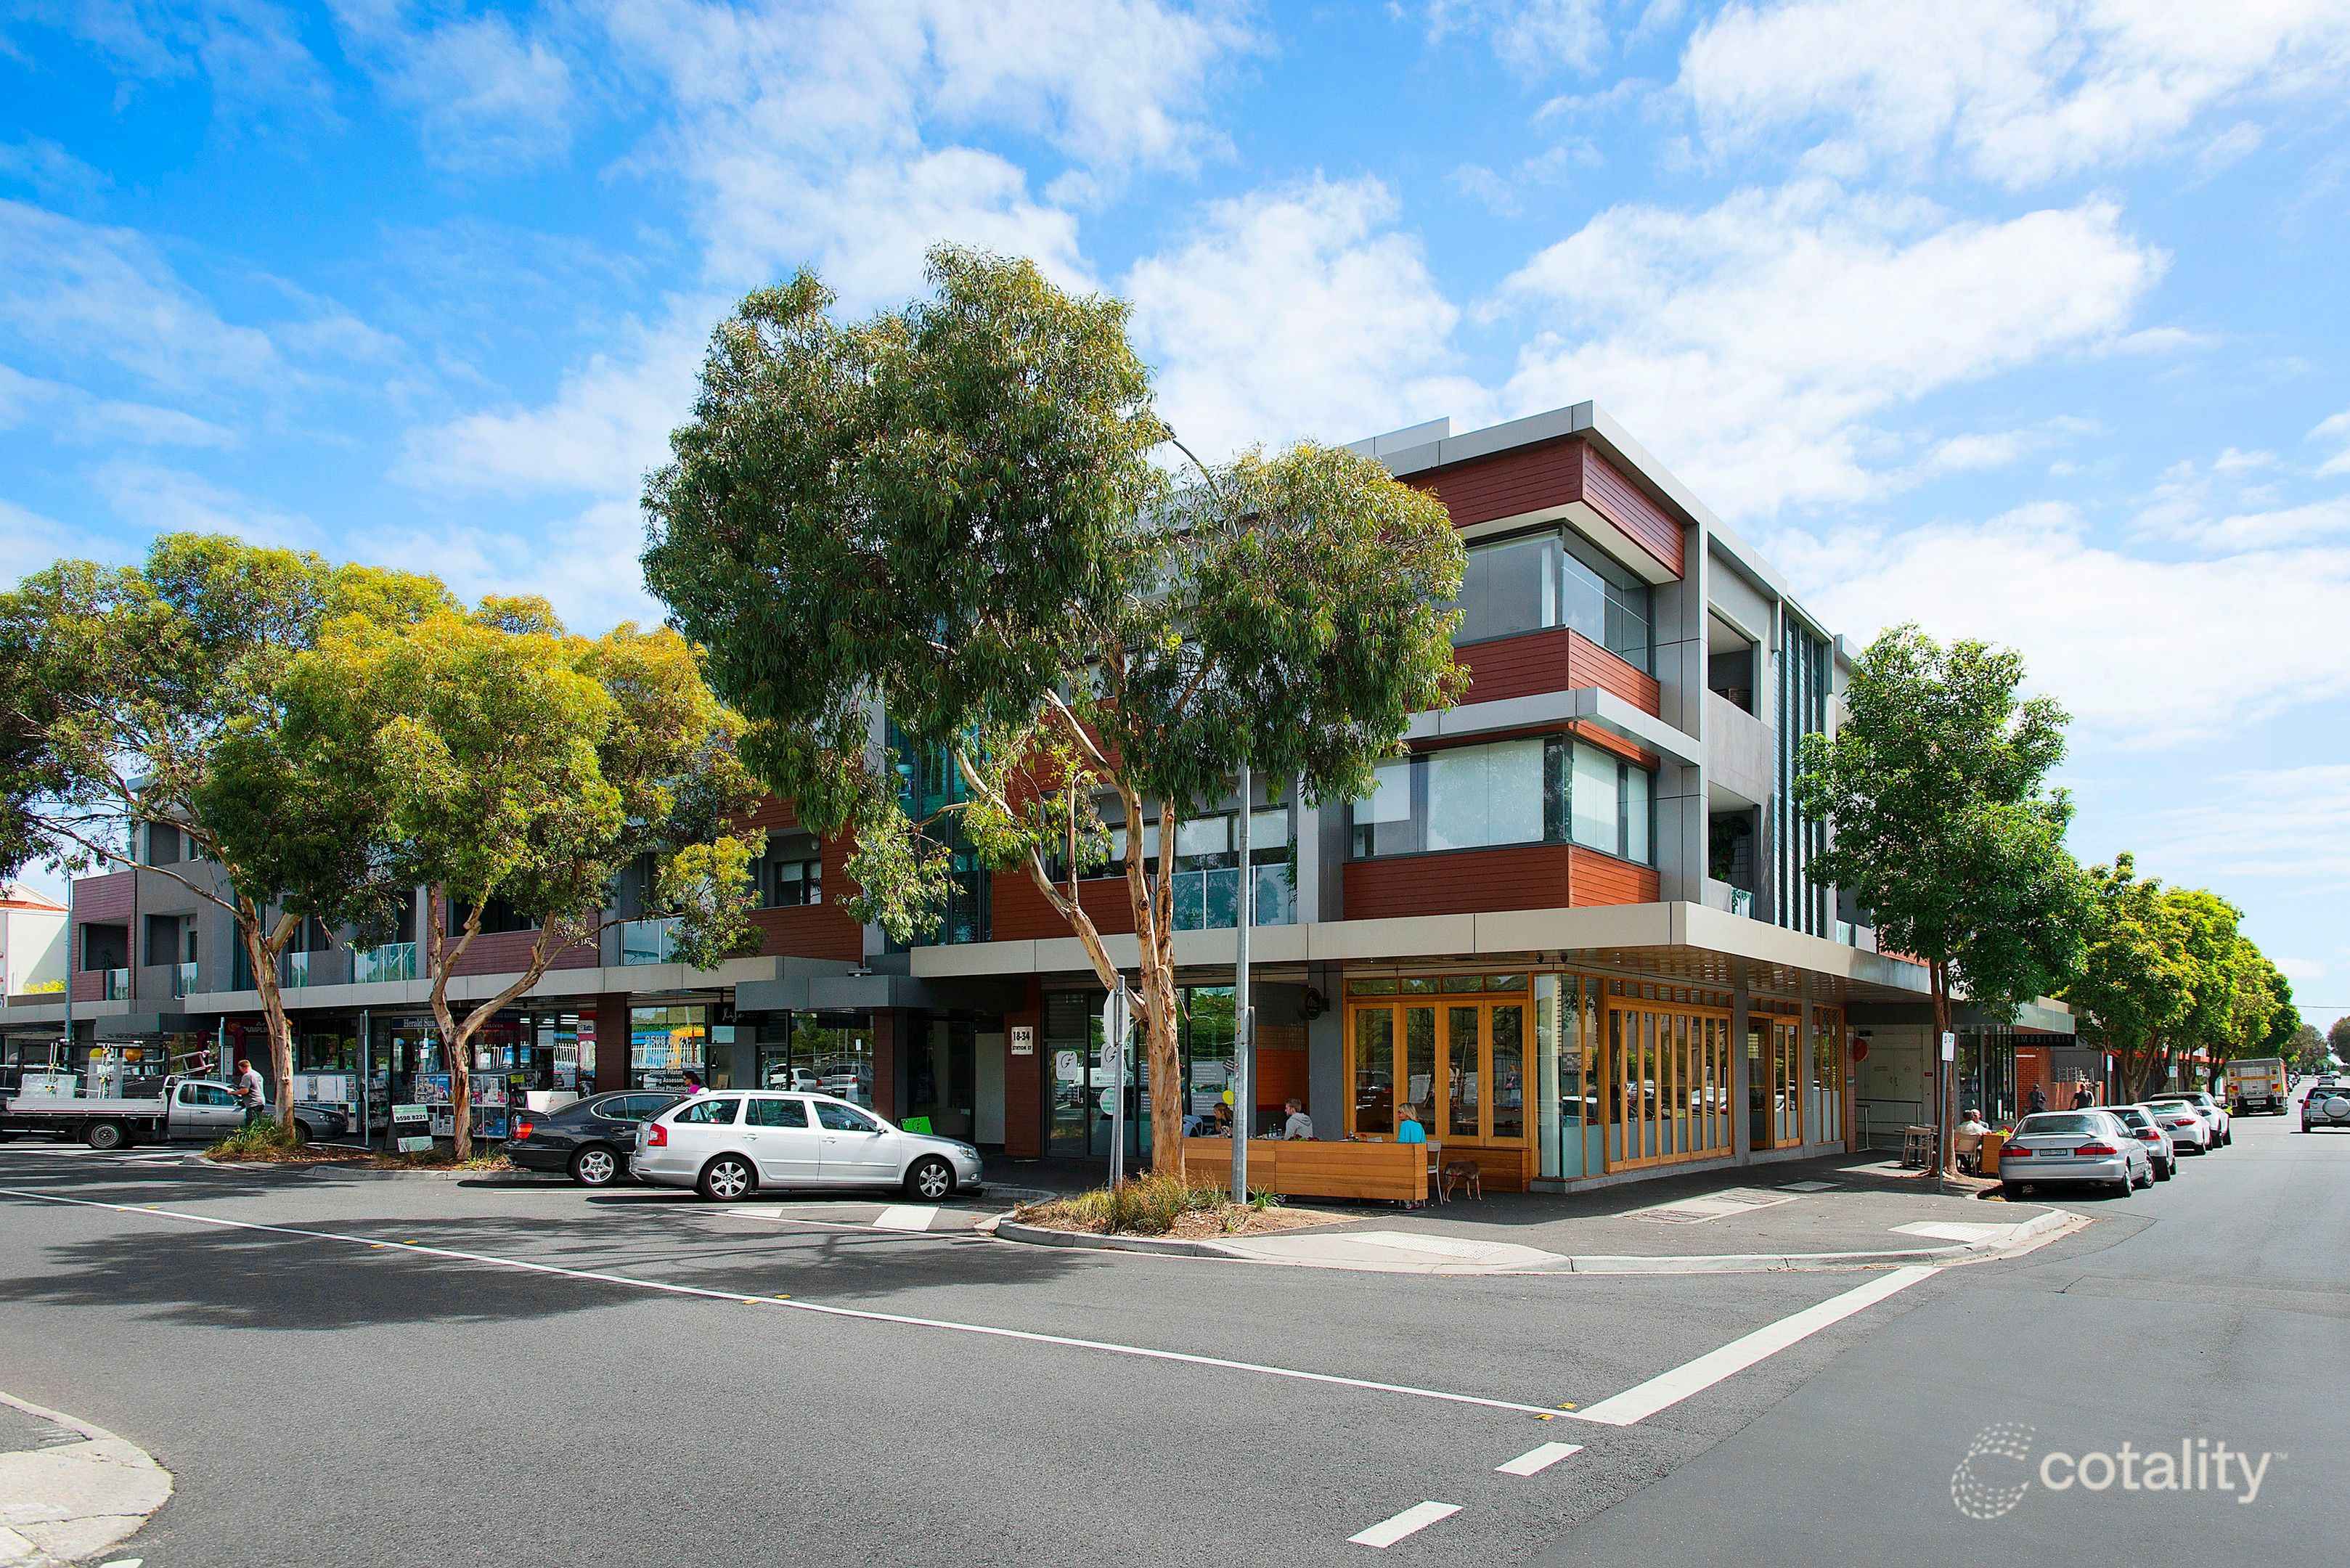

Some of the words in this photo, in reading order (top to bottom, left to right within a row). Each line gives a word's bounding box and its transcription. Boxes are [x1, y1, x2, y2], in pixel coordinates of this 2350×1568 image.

[404, 1018, 423, 1027] Herald
[424, 1018, 436, 1026] Sun
[668, 1036, 689, 1045] 821
[1013, 1031, 1030, 1041] 18-34
